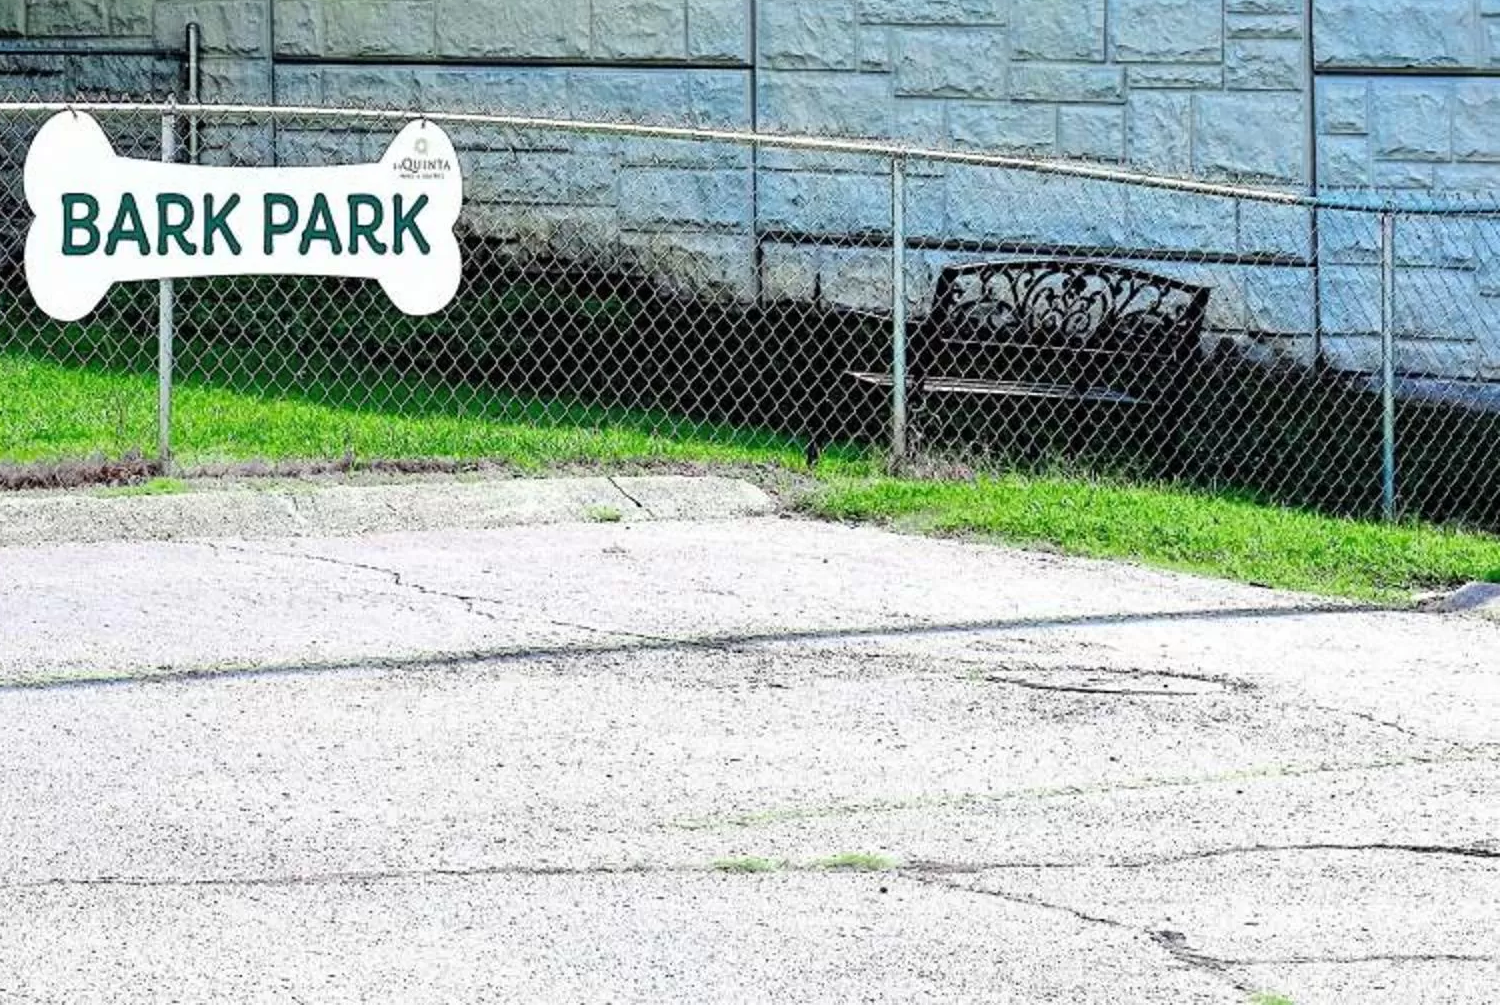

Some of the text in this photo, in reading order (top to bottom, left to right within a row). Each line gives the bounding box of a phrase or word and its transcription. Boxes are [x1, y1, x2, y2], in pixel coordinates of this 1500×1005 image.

[402, 157, 451, 173] QUINTA
[62, 193, 430, 255] BARK PARK
